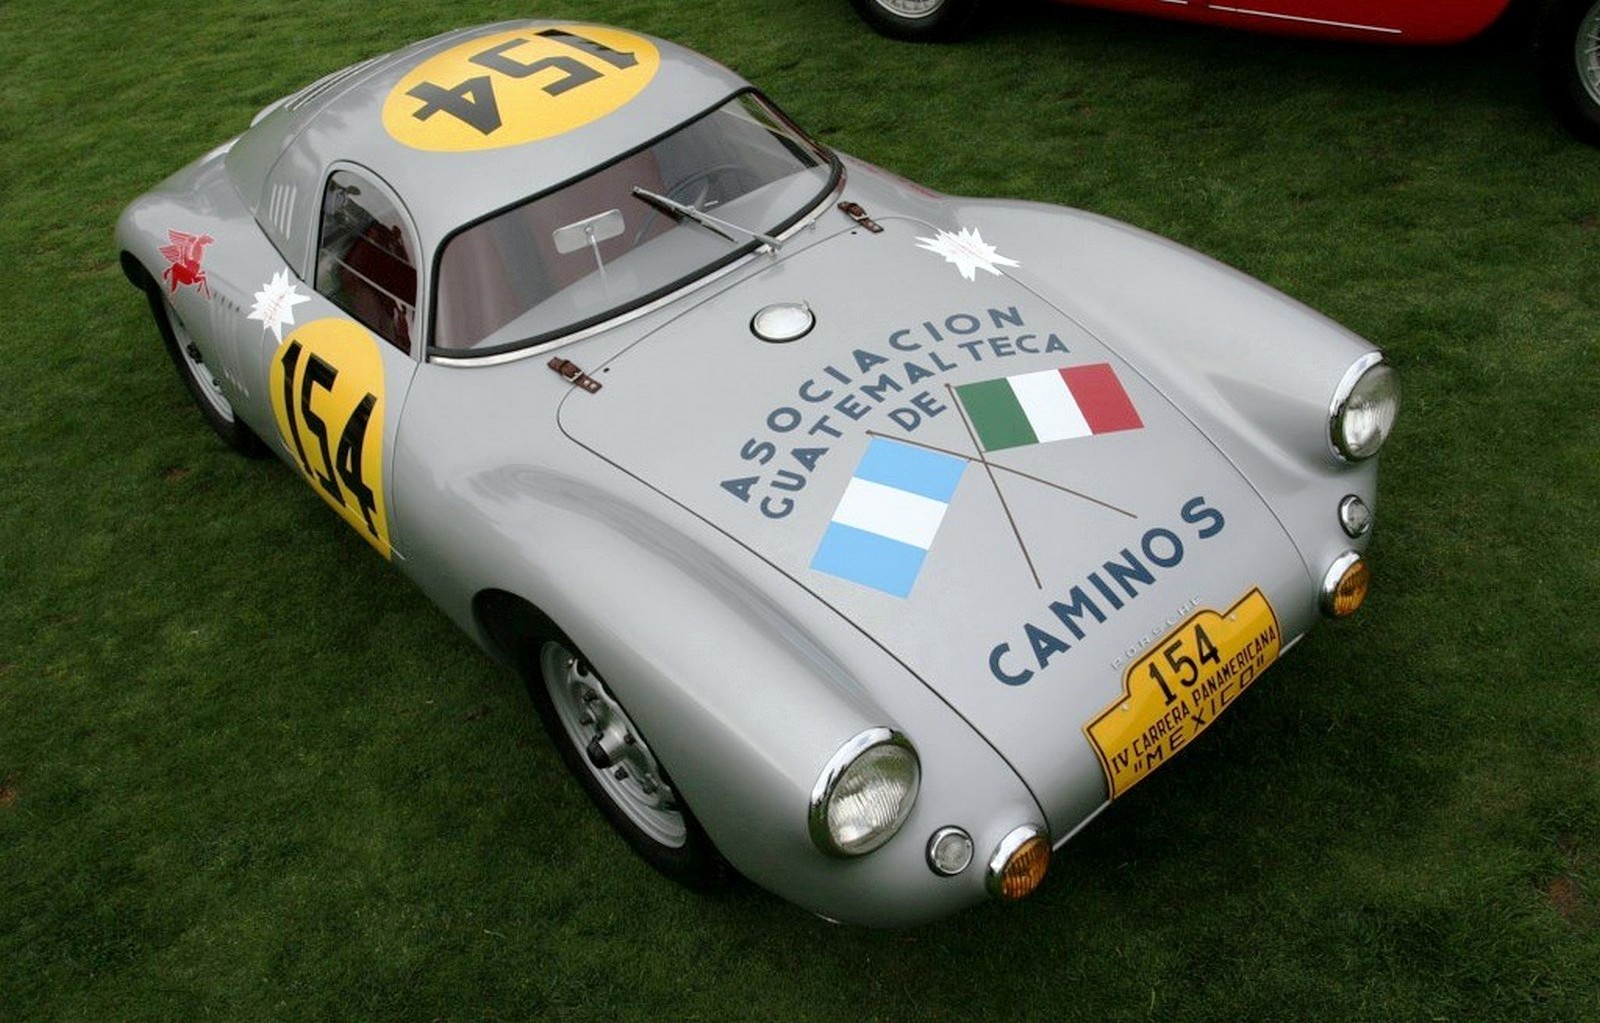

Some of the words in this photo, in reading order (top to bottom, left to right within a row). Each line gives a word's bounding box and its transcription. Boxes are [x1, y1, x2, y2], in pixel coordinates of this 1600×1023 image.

[405, 29, 639, 136] 154
[281, 339, 379, 539] 154
[719, 306, 1026, 503] ASOCIACION
[888, 391, 947, 432] DE
[989, 497, 1225, 686] CAMINOS
[1111, 596, 1201, 671] PORSCHE
[1111, 748, 1130, 774] IV
[1132, 701, 1190, 757] CARRERA
[1192, 626, 1277, 707] PANAMERICANA
[1149, 623, 1221, 706] 154
